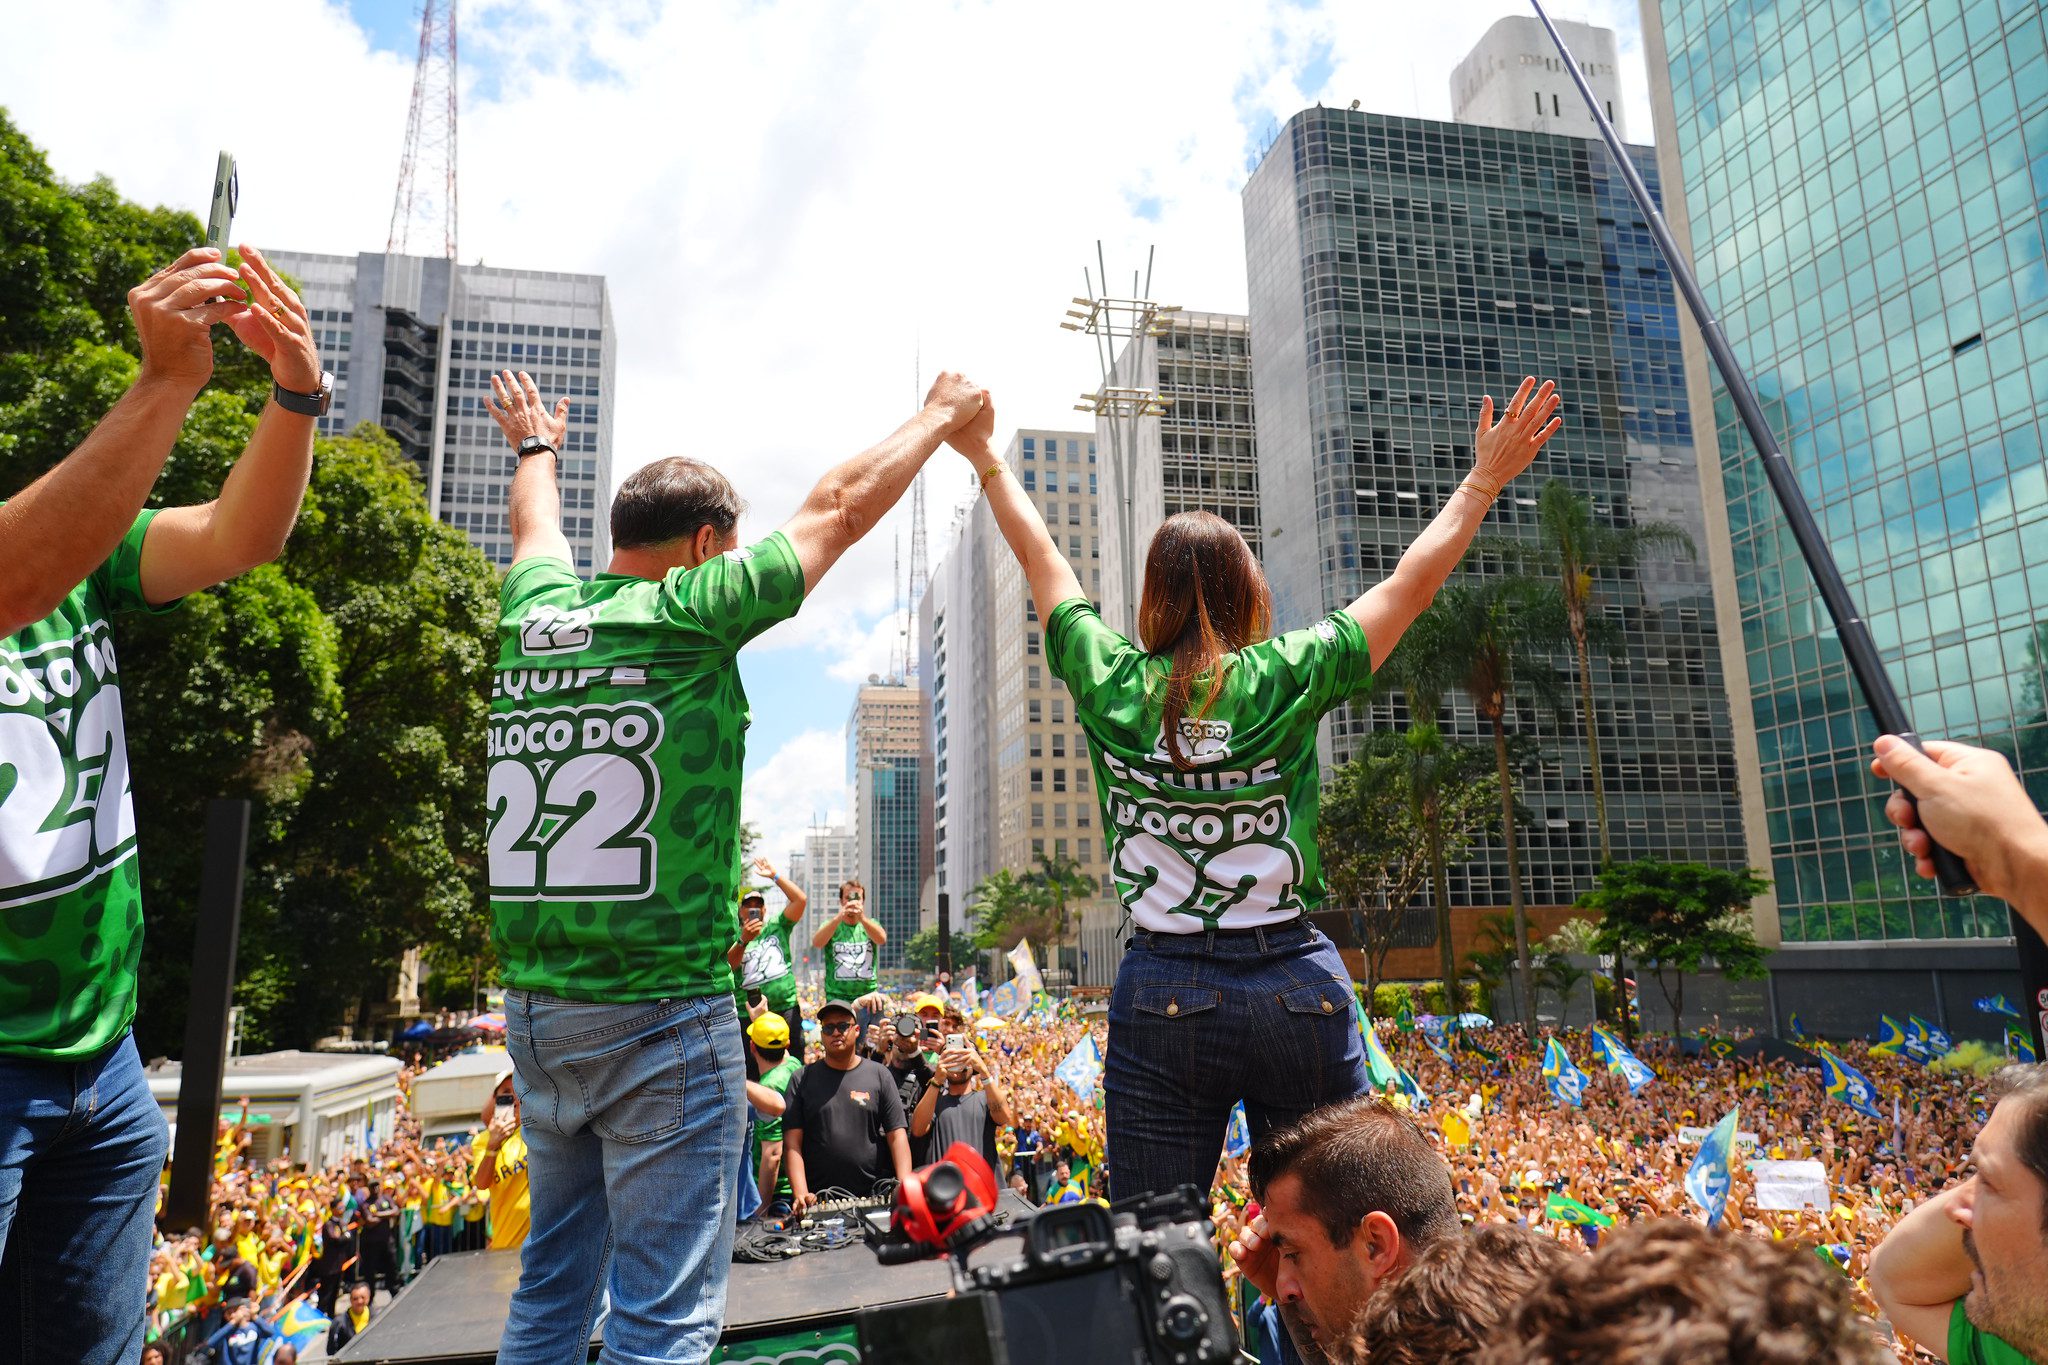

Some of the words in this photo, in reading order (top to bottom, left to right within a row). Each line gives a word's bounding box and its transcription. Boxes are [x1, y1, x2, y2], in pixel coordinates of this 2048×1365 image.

[522, 608, 592, 648] 22
[582, 714, 649, 749] DO
[488, 753, 645, 887] 22
[1233, 806, 1280, 842] DO
[1118, 832, 1300, 935] 22
